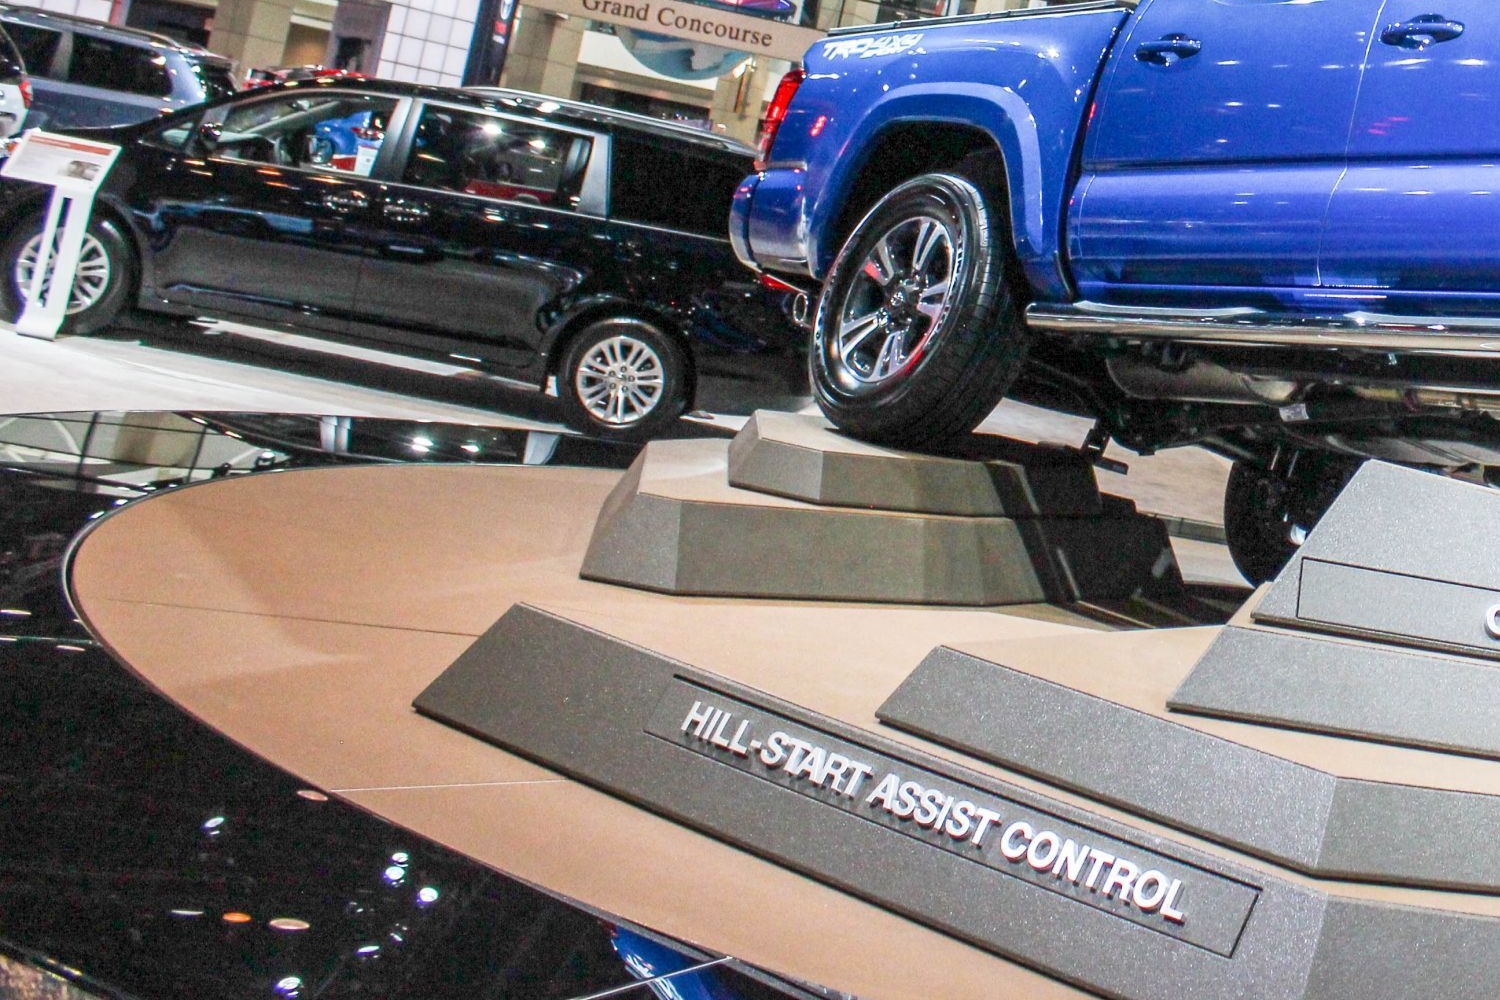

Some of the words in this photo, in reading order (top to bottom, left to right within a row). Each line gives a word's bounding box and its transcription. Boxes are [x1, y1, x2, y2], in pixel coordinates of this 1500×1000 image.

[657, 7, 773, 47] Concourse
[680, 701, 873, 798] HILL-START
[866, 773, 1000, 846] ASSIST
[1000, 821, 1186, 924] CONTROL
